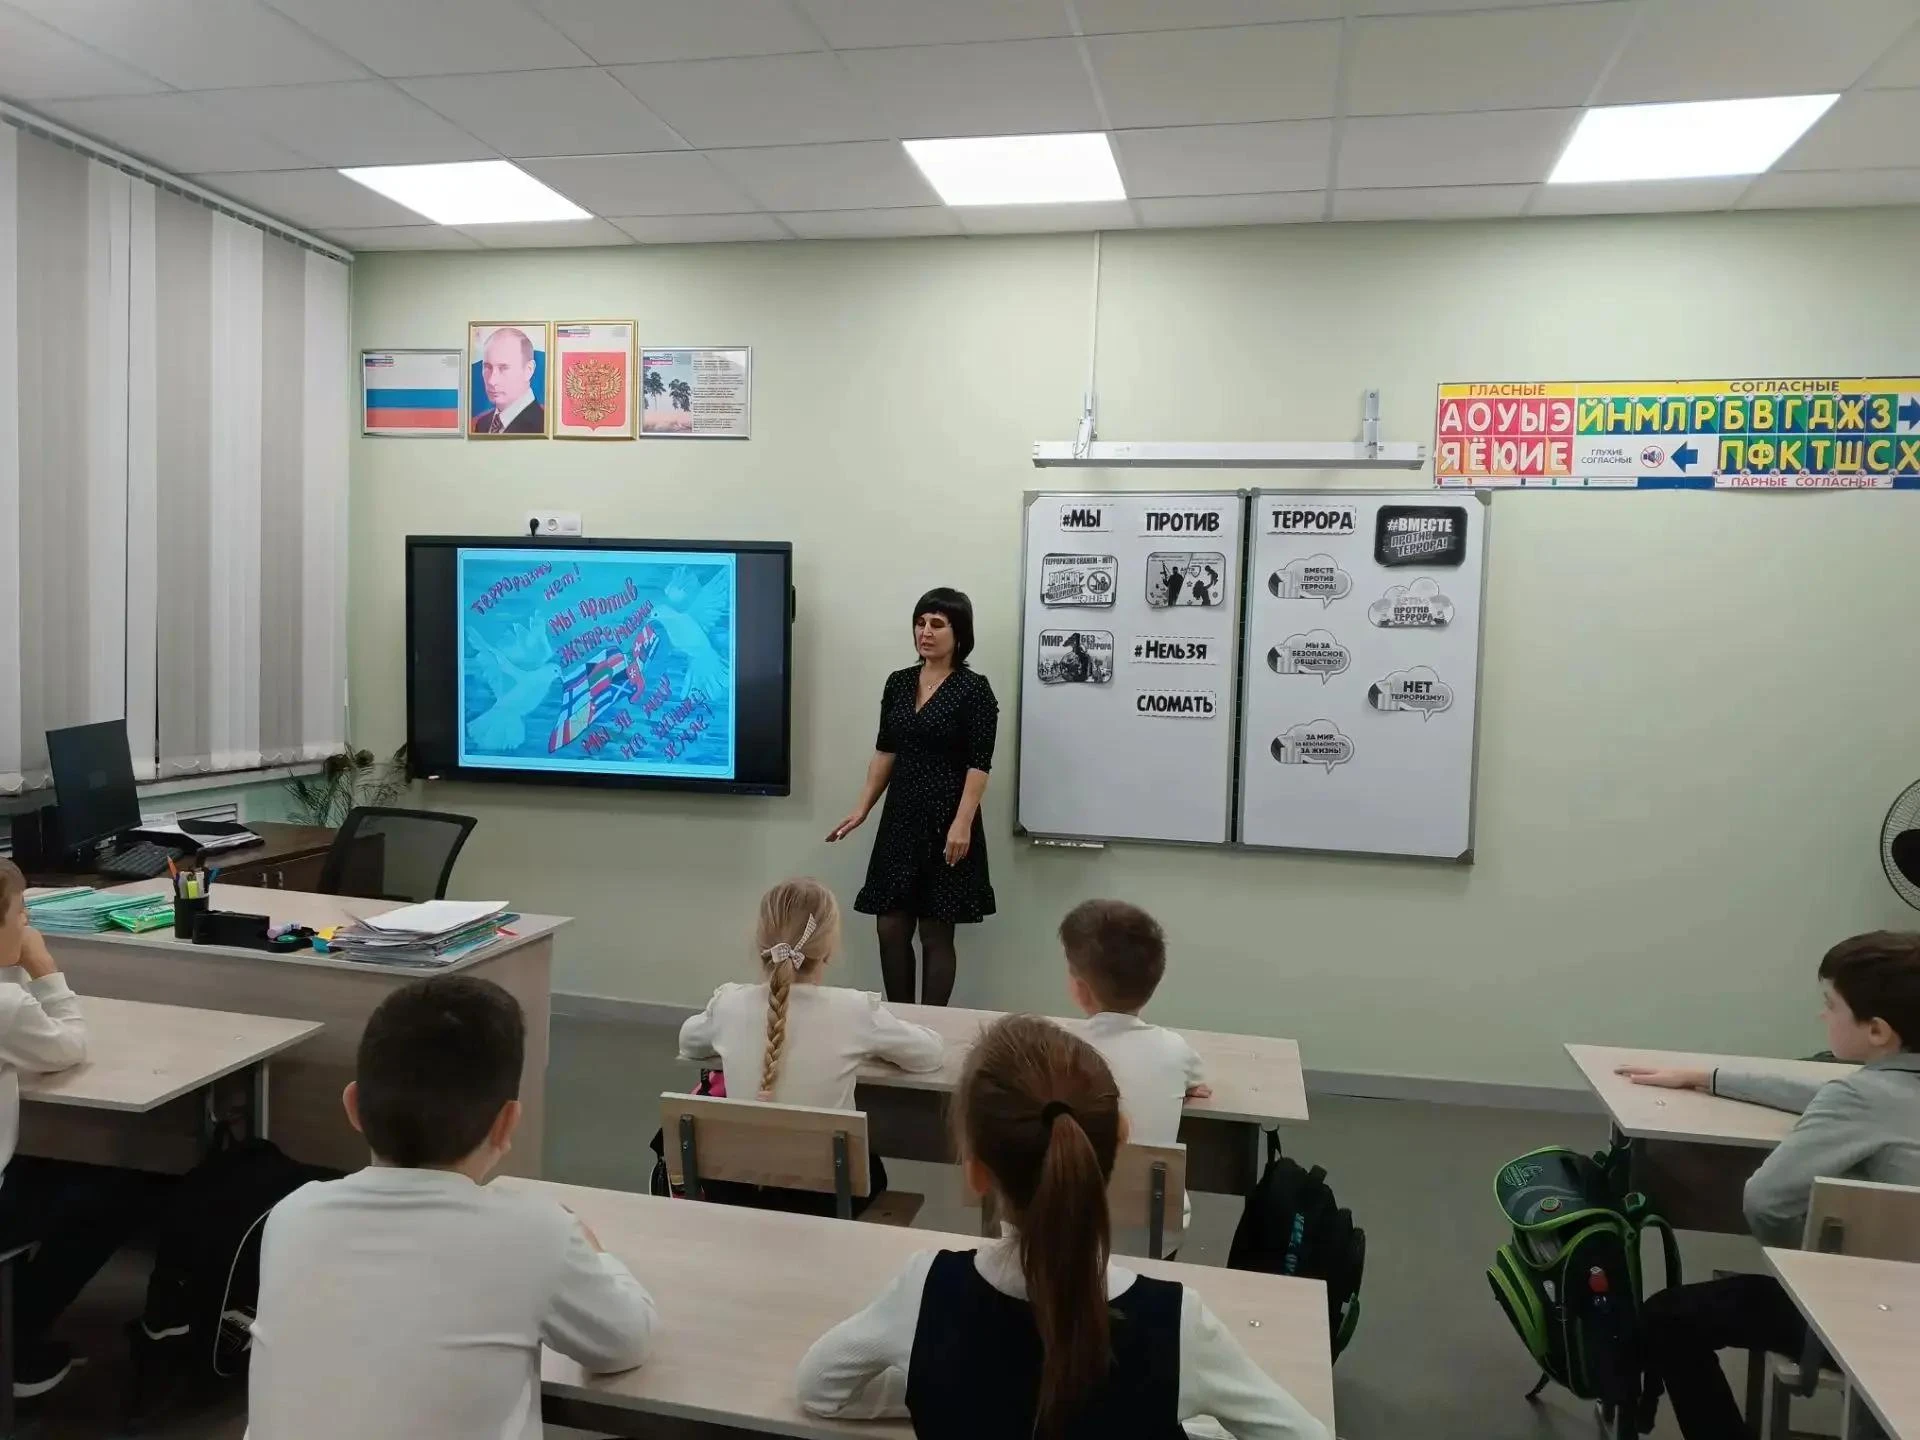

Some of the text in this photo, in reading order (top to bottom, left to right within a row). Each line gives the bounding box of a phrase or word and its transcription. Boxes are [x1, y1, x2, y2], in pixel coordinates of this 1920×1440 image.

[1469, 385, 1546, 396] ГЛАСНЫЕ
[1729, 381, 1840, 393] СОГЛАСНЫЕ
[1591, 448, 1624, 456] ГЛУХИЕ
[1581, 456, 1632, 465] СОГЛАСНЫЕ
[1731, 478, 1878, 488] ПАРНЫЕ СОГЛАСНЫЕ
[1062, 509, 1354, 531] #МЫ ПРОТИВ ТЕРРОРА
[1387, 517, 1453, 532] #ВМЕСТЕ
[1398, 537, 1448, 557] ТЕРРОРА!
[1394, 606, 1430, 614] ПРОТИВ
[1041, 634, 1096, 647] МИР БЕЗ
[1294, 658, 1341, 666] ОБЩЕСТВО!
[1403, 680, 1432, 693] НЕТ
[1136, 695, 1214, 713] СЛОМАТЬ
